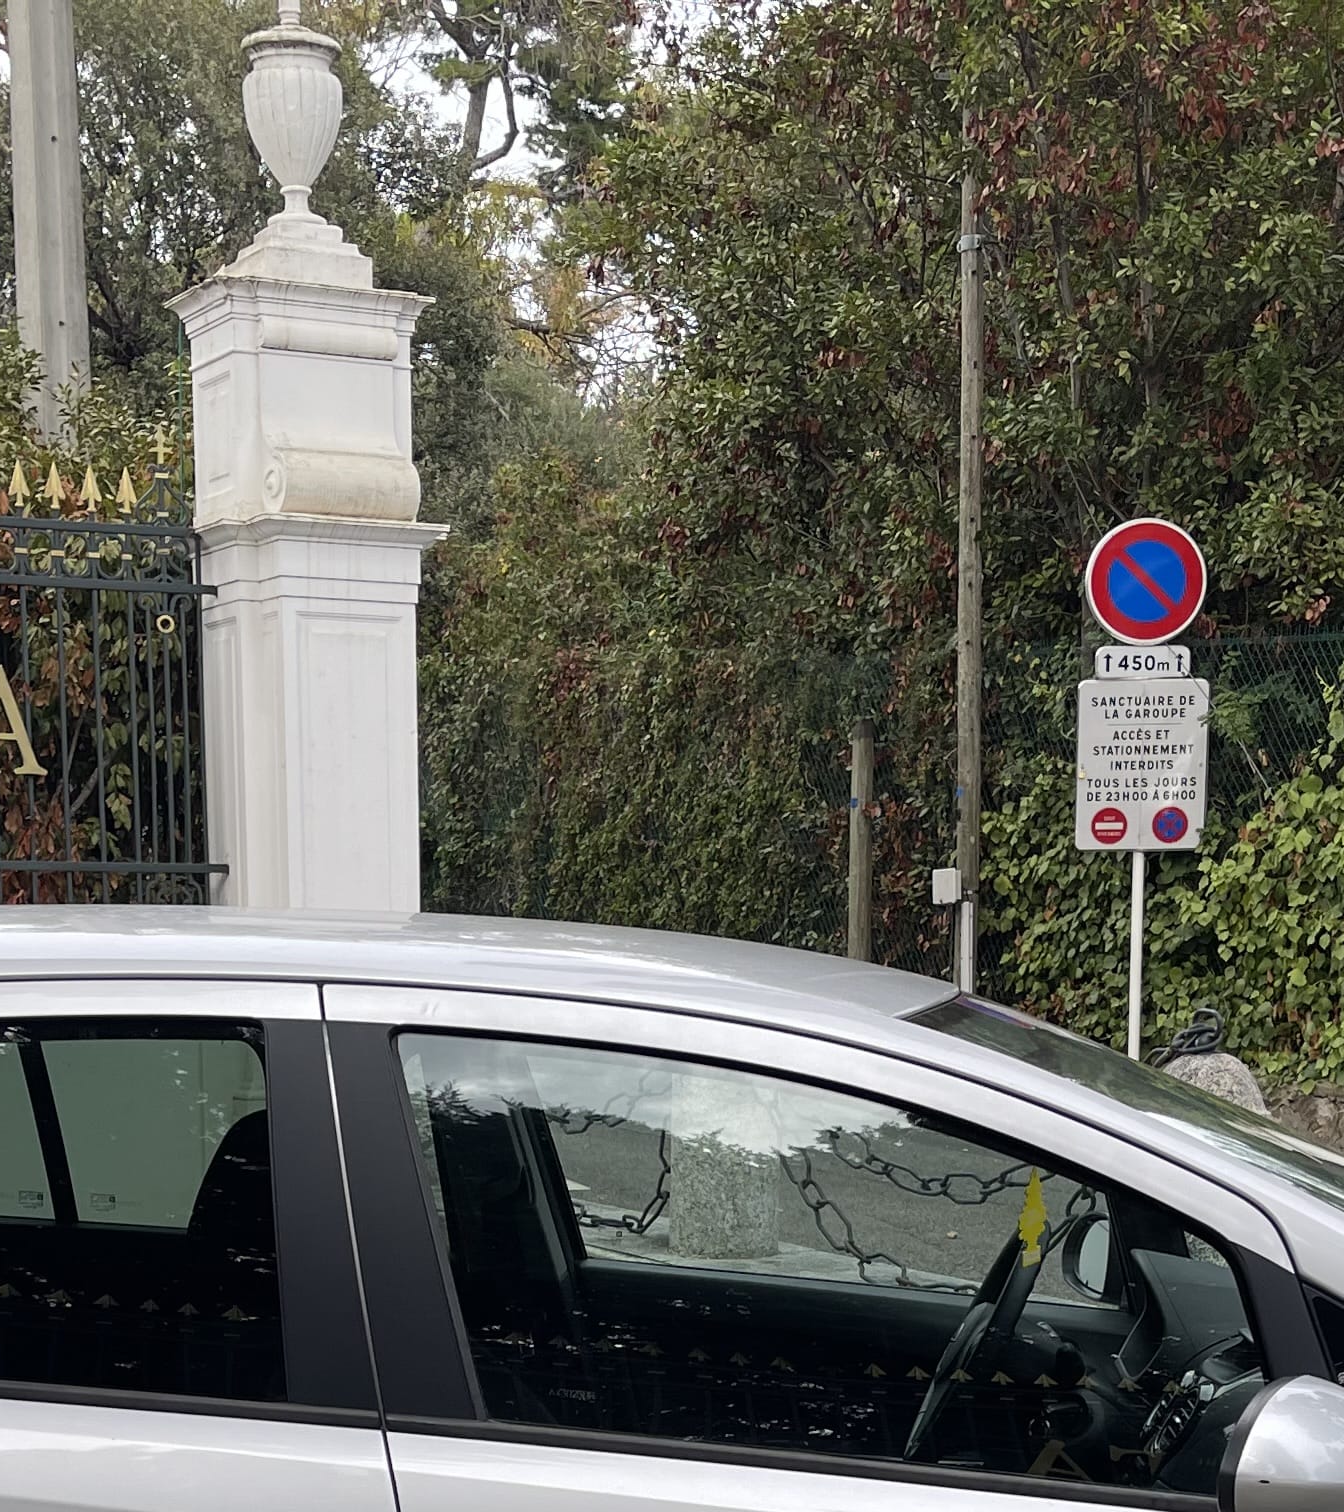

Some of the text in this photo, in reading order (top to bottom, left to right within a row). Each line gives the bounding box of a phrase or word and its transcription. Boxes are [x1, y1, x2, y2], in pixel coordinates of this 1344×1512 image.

[1118, 655, 1170, 671] 450m
[1091, 695, 1196, 707] SANCTUAIRE DE
[1104, 707, 1187, 719] LA GAROUPE
[1112, 728, 1170, 741] ACCÈS ET
[1093, 744, 1194, 756] STATIONNEMENT
[1110, 759, 1174, 771] INTERDITS
[1087, 776, 1197, 789] TOUS LES JOURS
[1086, 792, 1102, 802] DE
